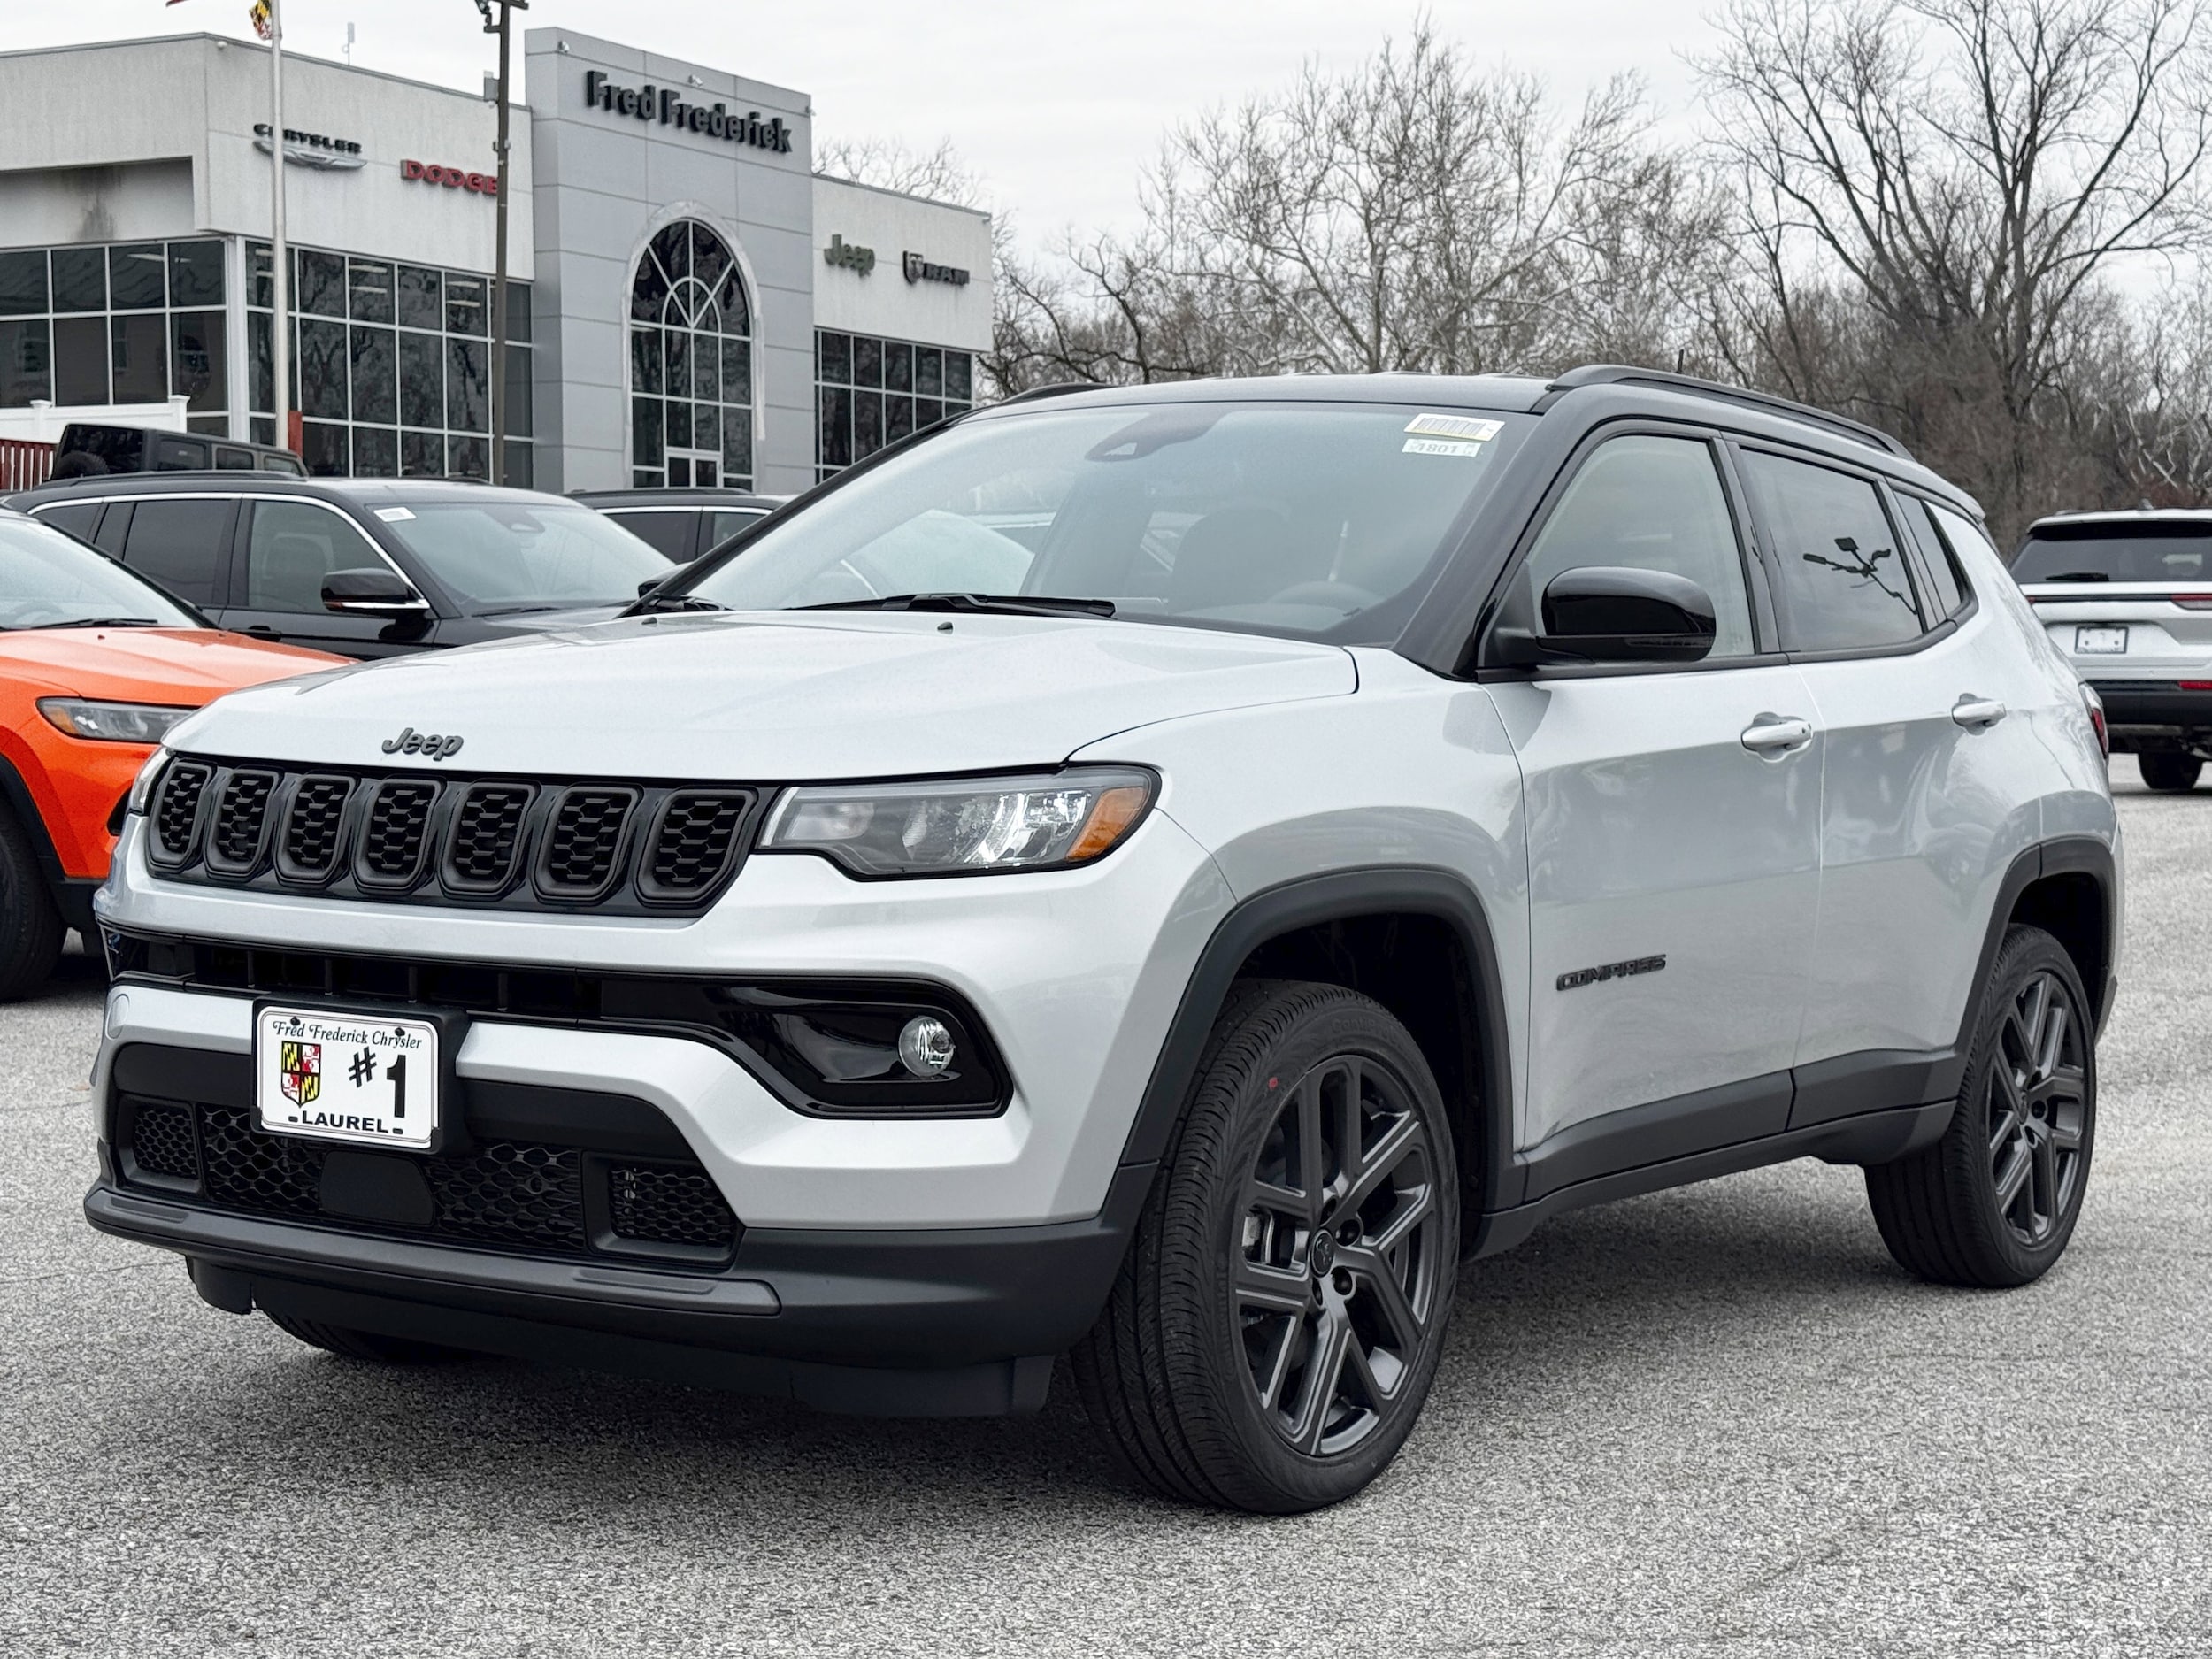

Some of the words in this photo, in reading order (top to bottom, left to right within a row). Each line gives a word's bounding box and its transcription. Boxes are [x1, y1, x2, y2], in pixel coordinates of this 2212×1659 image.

[586, 71, 656, 120] Fred
[660, 89, 793, 153] Frederick
[400, 158, 497, 196] DODGE
[824, 234, 875, 278] Jeep
[924, 263, 970, 285] RAM
[381, 727, 464, 762] Jeep
[1556, 954, 1666, 991] COMPASS
[273, 1019, 305, 1038] Fred
[309, 1024, 368, 1044] Frederick
[372, 1030, 422, 1050] Chrysler
[348, 1046, 407, 1118] #1
[302, 1110, 388, 1133] LAUREL
